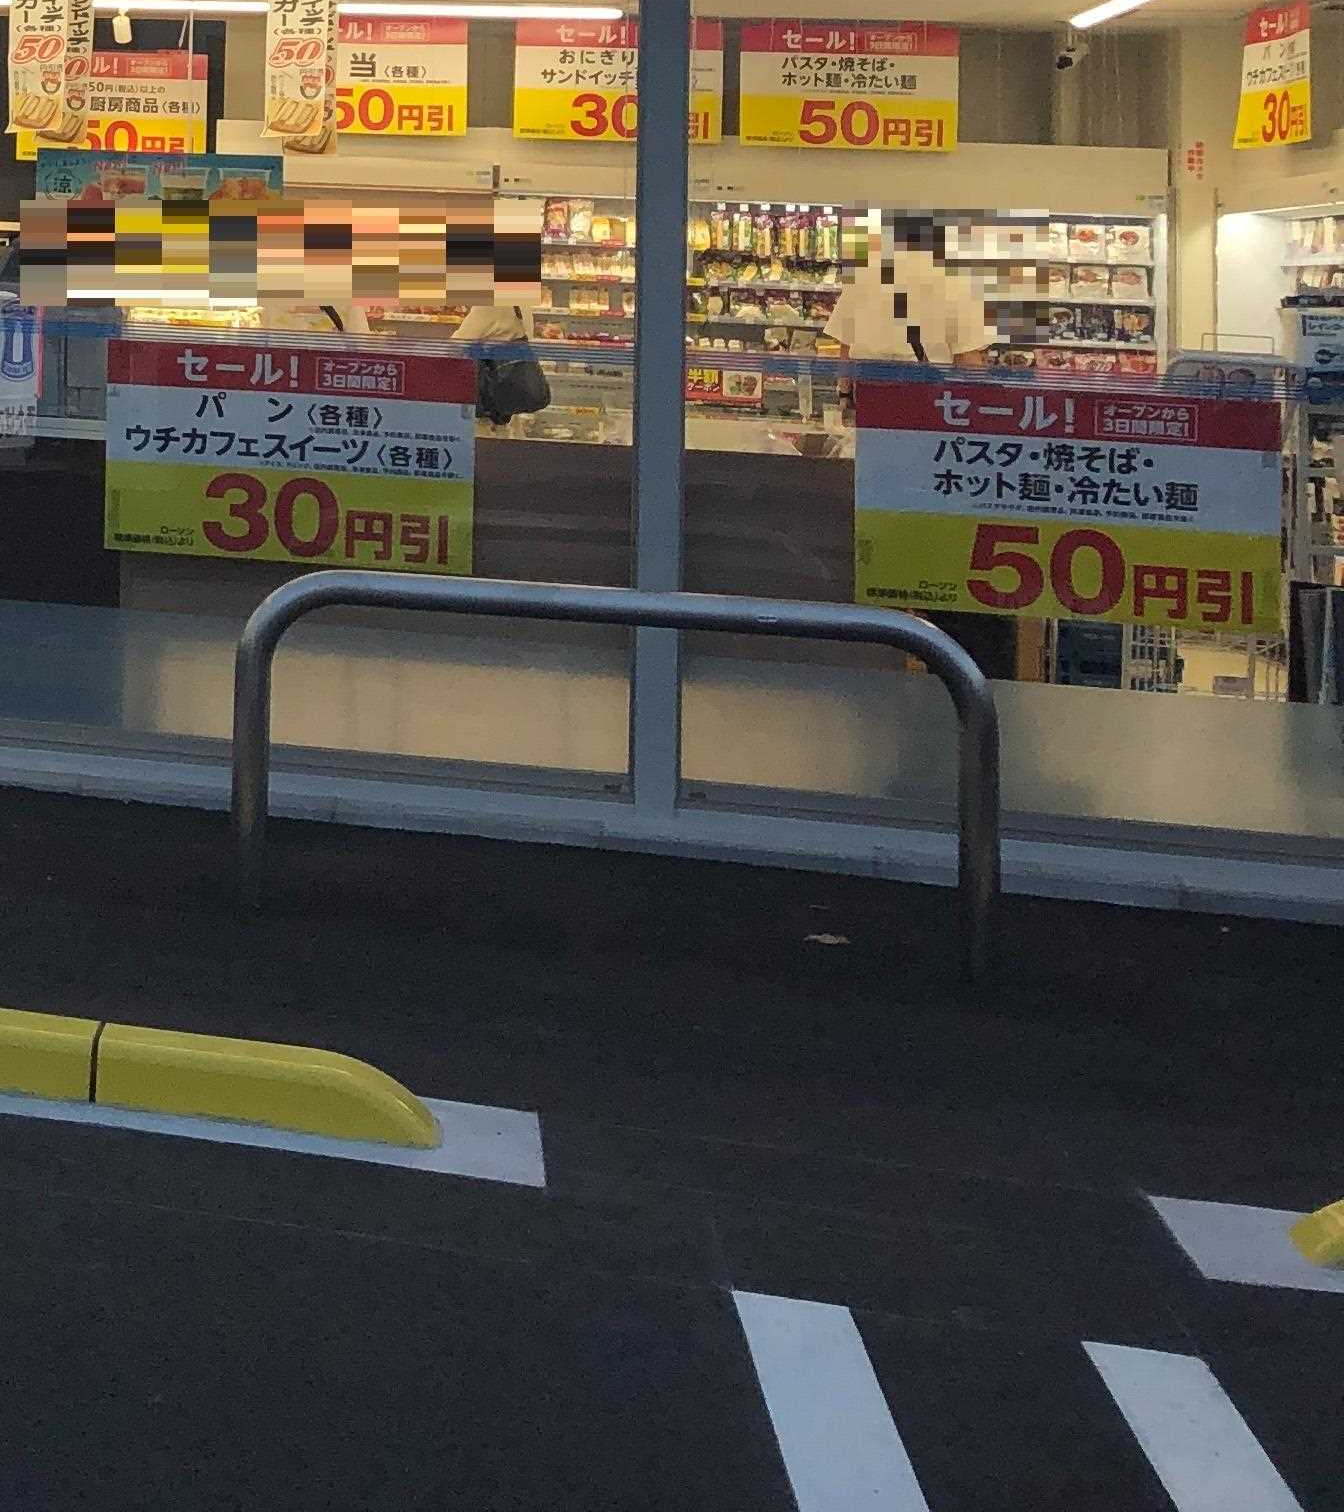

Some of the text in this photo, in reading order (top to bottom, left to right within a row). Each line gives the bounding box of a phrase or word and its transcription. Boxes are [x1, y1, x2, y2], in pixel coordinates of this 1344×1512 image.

[11, 35, 64, 63] 50
[555, 25, 626, 45] セール!
[782, 29, 856, 51] セール!
[269, 38, 324, 66] 50
[559, 49, 635, 66] おにぎり
[781, 72, 918, 90] ホット麺・冷たい麺
[336, 88, 454, 132] 50円引
[798, 99, 944, 148] 50円引
[176, 347, 299, 388] セール!
[322, 360, 398, 377] オープンから
[933, 390, 1076, 434] セール!
[1103, 404, 1191, 422] オープンから
[933, 468, 1200, 513] ホット麺・冷たい麺
[201, 472, 450, 565] 30円引
[966, 522, 1255, 626] 50円引
